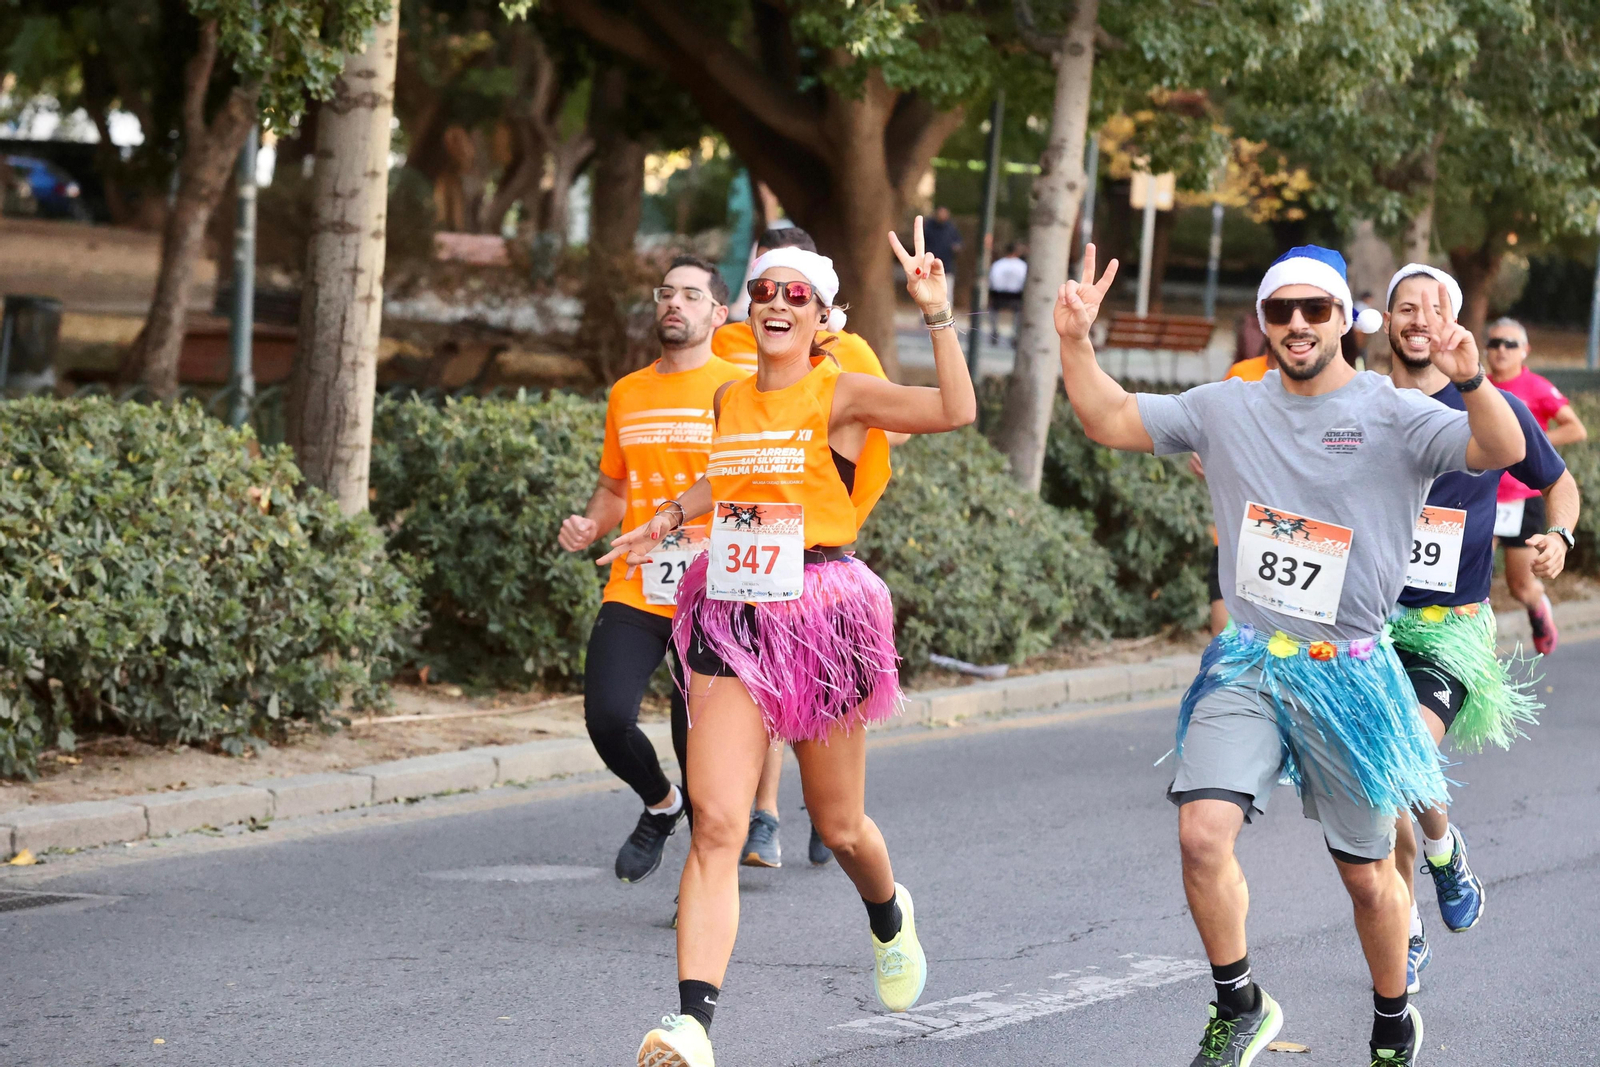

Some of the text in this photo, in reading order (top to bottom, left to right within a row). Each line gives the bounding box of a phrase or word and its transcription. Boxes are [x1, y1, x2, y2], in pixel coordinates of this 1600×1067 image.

[637, 436, 713, 445] PALMA PALMILLA
[796, 429, 813, 442] XII
[754, 448, 805, 457] CARRERA
[741, 456, 805, 465] SAN SILVESTRE
[722, 464, 804, 476] PALMA PALMILLA
[773, 518, 801, 526] XII
[1439, 520, 1463, 529] XII
[1321, 537, 1348, 549] XII
[725, 543, 781, 574] 347
[1258, 551, 1322, 590] 837
